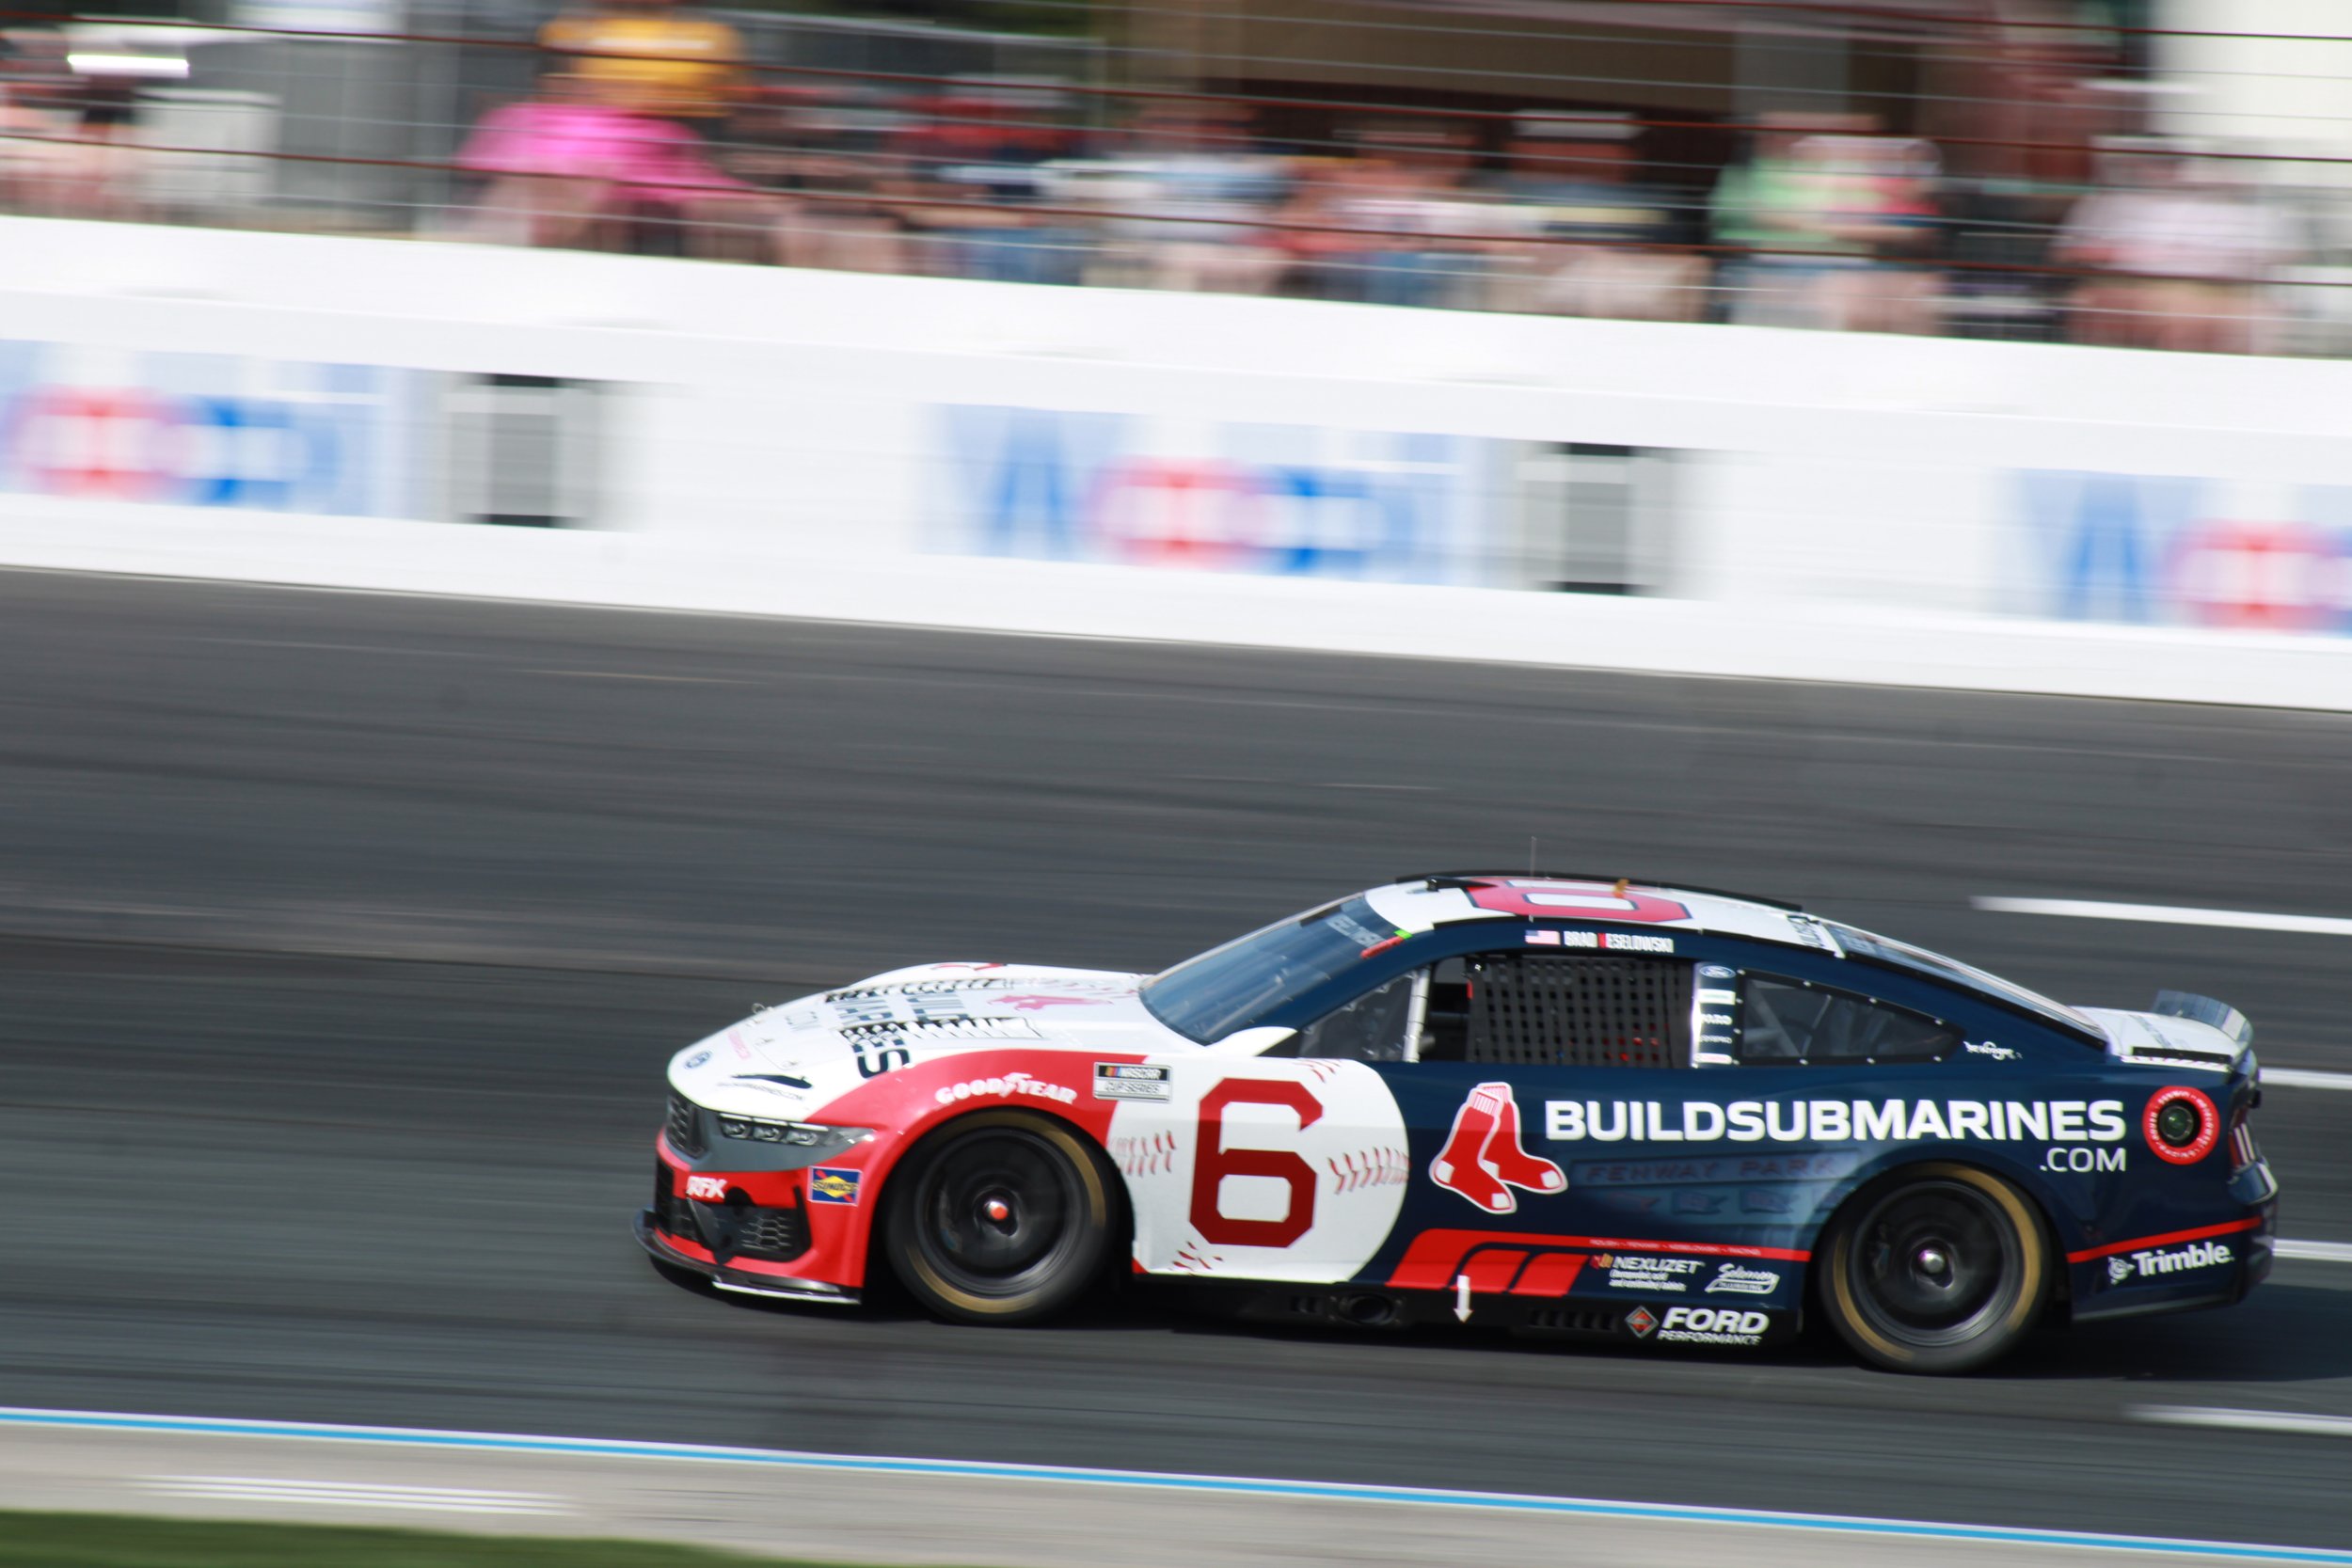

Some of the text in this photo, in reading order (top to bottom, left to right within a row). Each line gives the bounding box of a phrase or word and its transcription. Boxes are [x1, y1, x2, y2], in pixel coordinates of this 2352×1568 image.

[1563, 930, 1674, 954] BRAD ESELOWSKI
[934, 1071, 1078, 1105] GOODYEAR
[1545, 1099, 2127, 1143] BUILDSUBMARINES
[1188, 1077, 1323, 1249] 6
[1740, 1155, 1834, 1176] PARK
[2039, 1148, 2127, 1173] .COM
[686, 1176, 727, 1199] RFK
[2132, 1242, 2232, 1276] Trimble
[1661, 1307, 1771, 1335] FORD
[1657, 1328, 1763, 1347] PERFORMANCE
